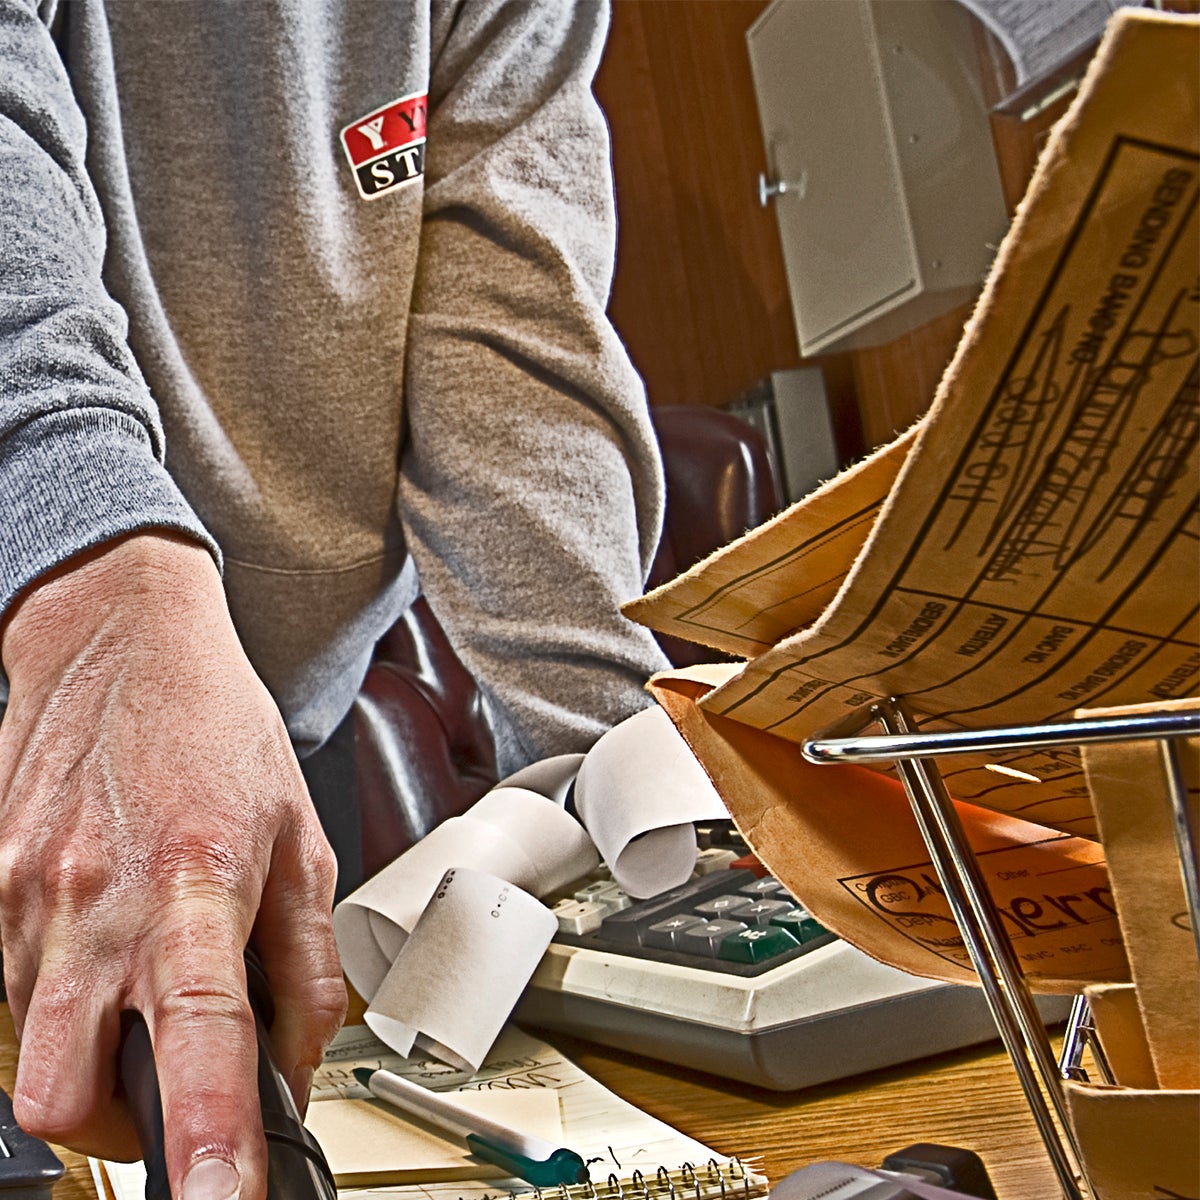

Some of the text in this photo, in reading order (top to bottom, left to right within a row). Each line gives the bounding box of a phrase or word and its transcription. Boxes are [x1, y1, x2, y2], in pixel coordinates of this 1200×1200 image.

[1120, 166, 1194, 269] SENDING
[954, 613, 1009, 657] ATTENTION
[880, 891, 911, 904] GBC
